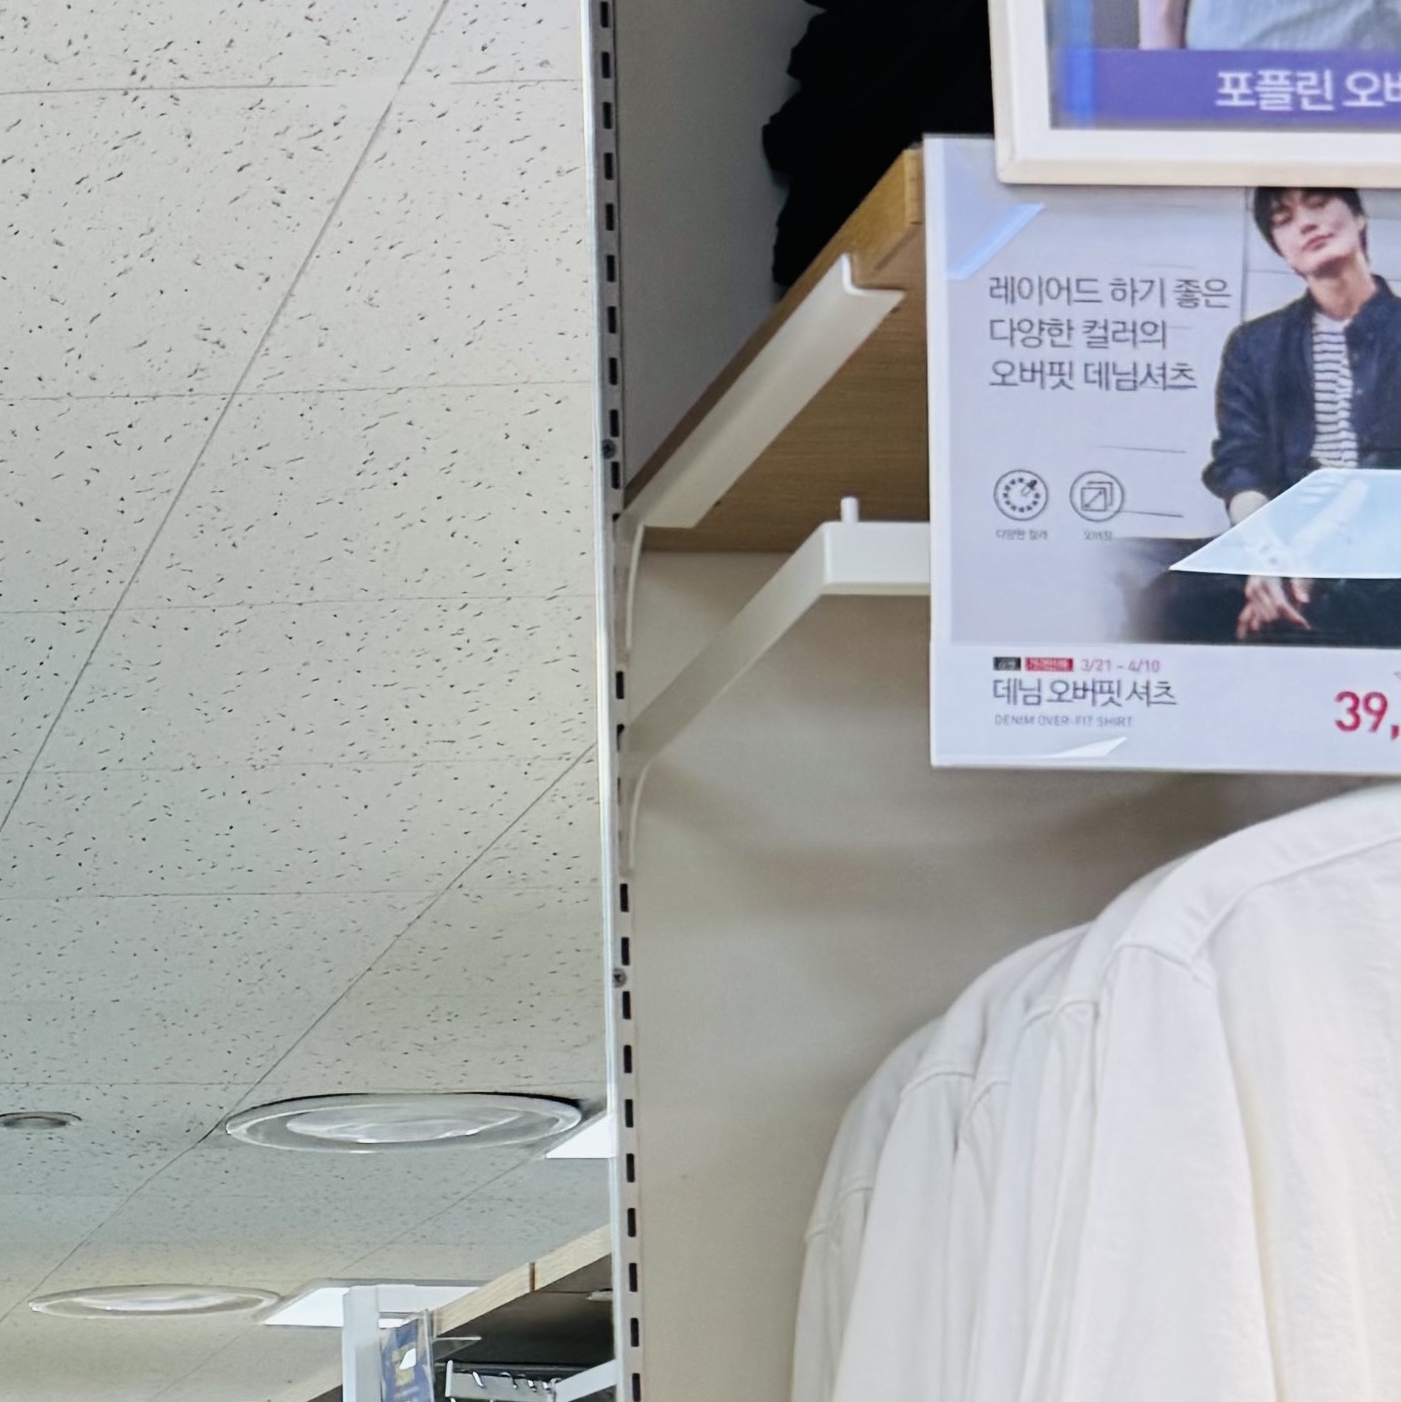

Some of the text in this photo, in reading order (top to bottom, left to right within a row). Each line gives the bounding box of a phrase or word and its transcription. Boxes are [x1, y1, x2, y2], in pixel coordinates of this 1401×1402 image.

[1215, 69, 1335, 112] 포플린
[989, 276, 1232, 310] 레이어드 하기 좋은
[989, 319, 1168, 351] 다양한 컬러의
[989, 360, 1075, 392] 오버핏
[1081, 658, 1112, 673] 3/21
[1128, 659, 1161, 673] 4/10
[993, 678, 1177, 707] 데님 오버핏 셔츠
